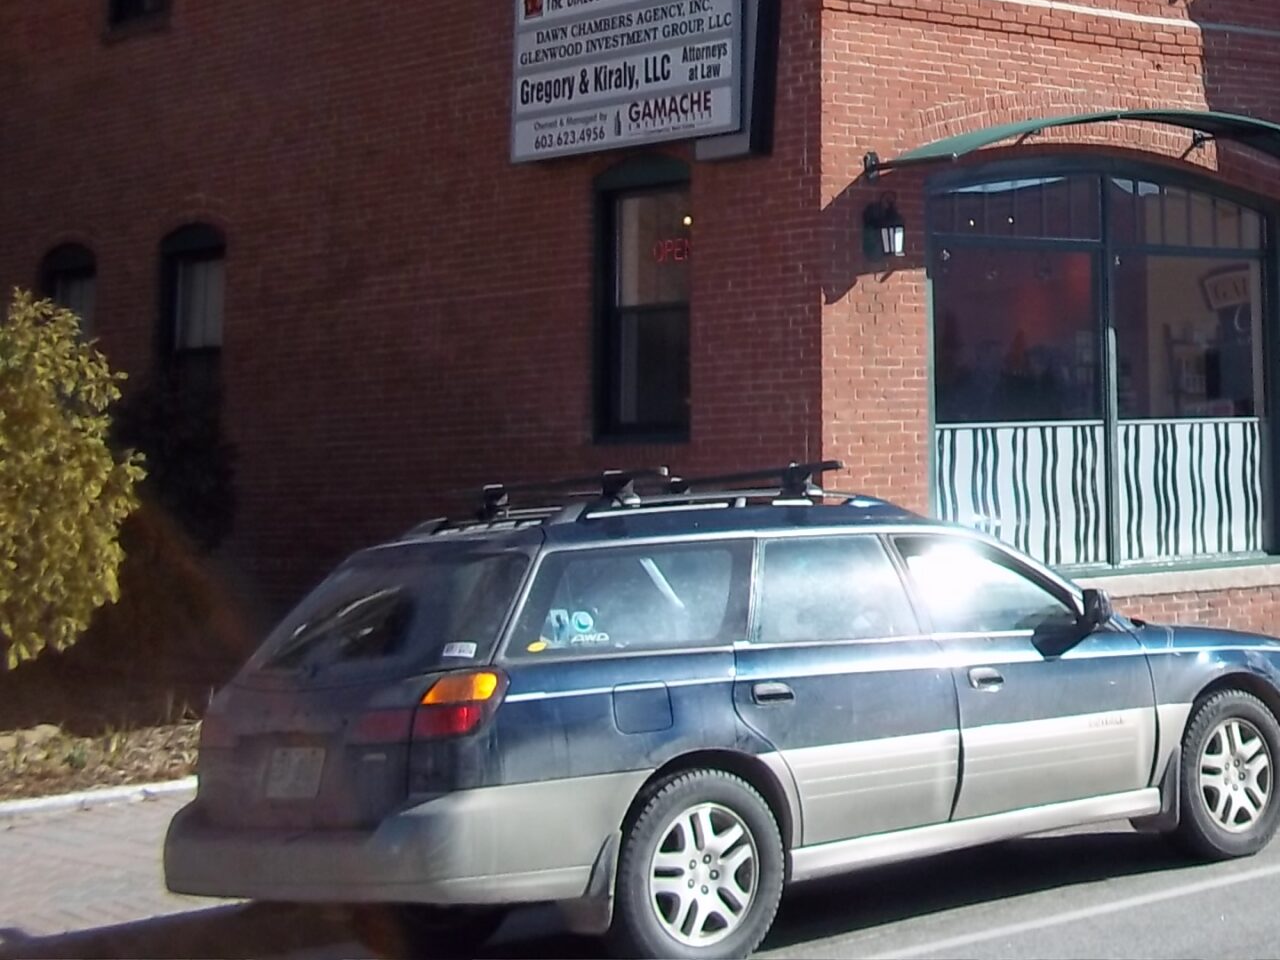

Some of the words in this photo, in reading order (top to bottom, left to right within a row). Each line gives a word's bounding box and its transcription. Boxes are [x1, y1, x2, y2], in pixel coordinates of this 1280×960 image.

[519, 41, 583, 66] GLENWOOD
[585, 27, 659, 54] INVESTMENT
[708, 11, 733, 31] LLC
[536, 26, 568, 45] DAWN
[570, 13, 633, 39] CHAMBERS
[635, 2, 686, 26] AGENCY,
[681, 41, 728, 64] Attorneys
[687, 64, 699, 81] at
[700, 62, 721, 80] Law
[520, 75, 576, 106] Gregory
[578, 67, 590, 95] &
[593, 60, 640, 93] Kiraly,
[644, 53, 671, 84] LLC
[628, 90, 713, 123] GAMACHE
